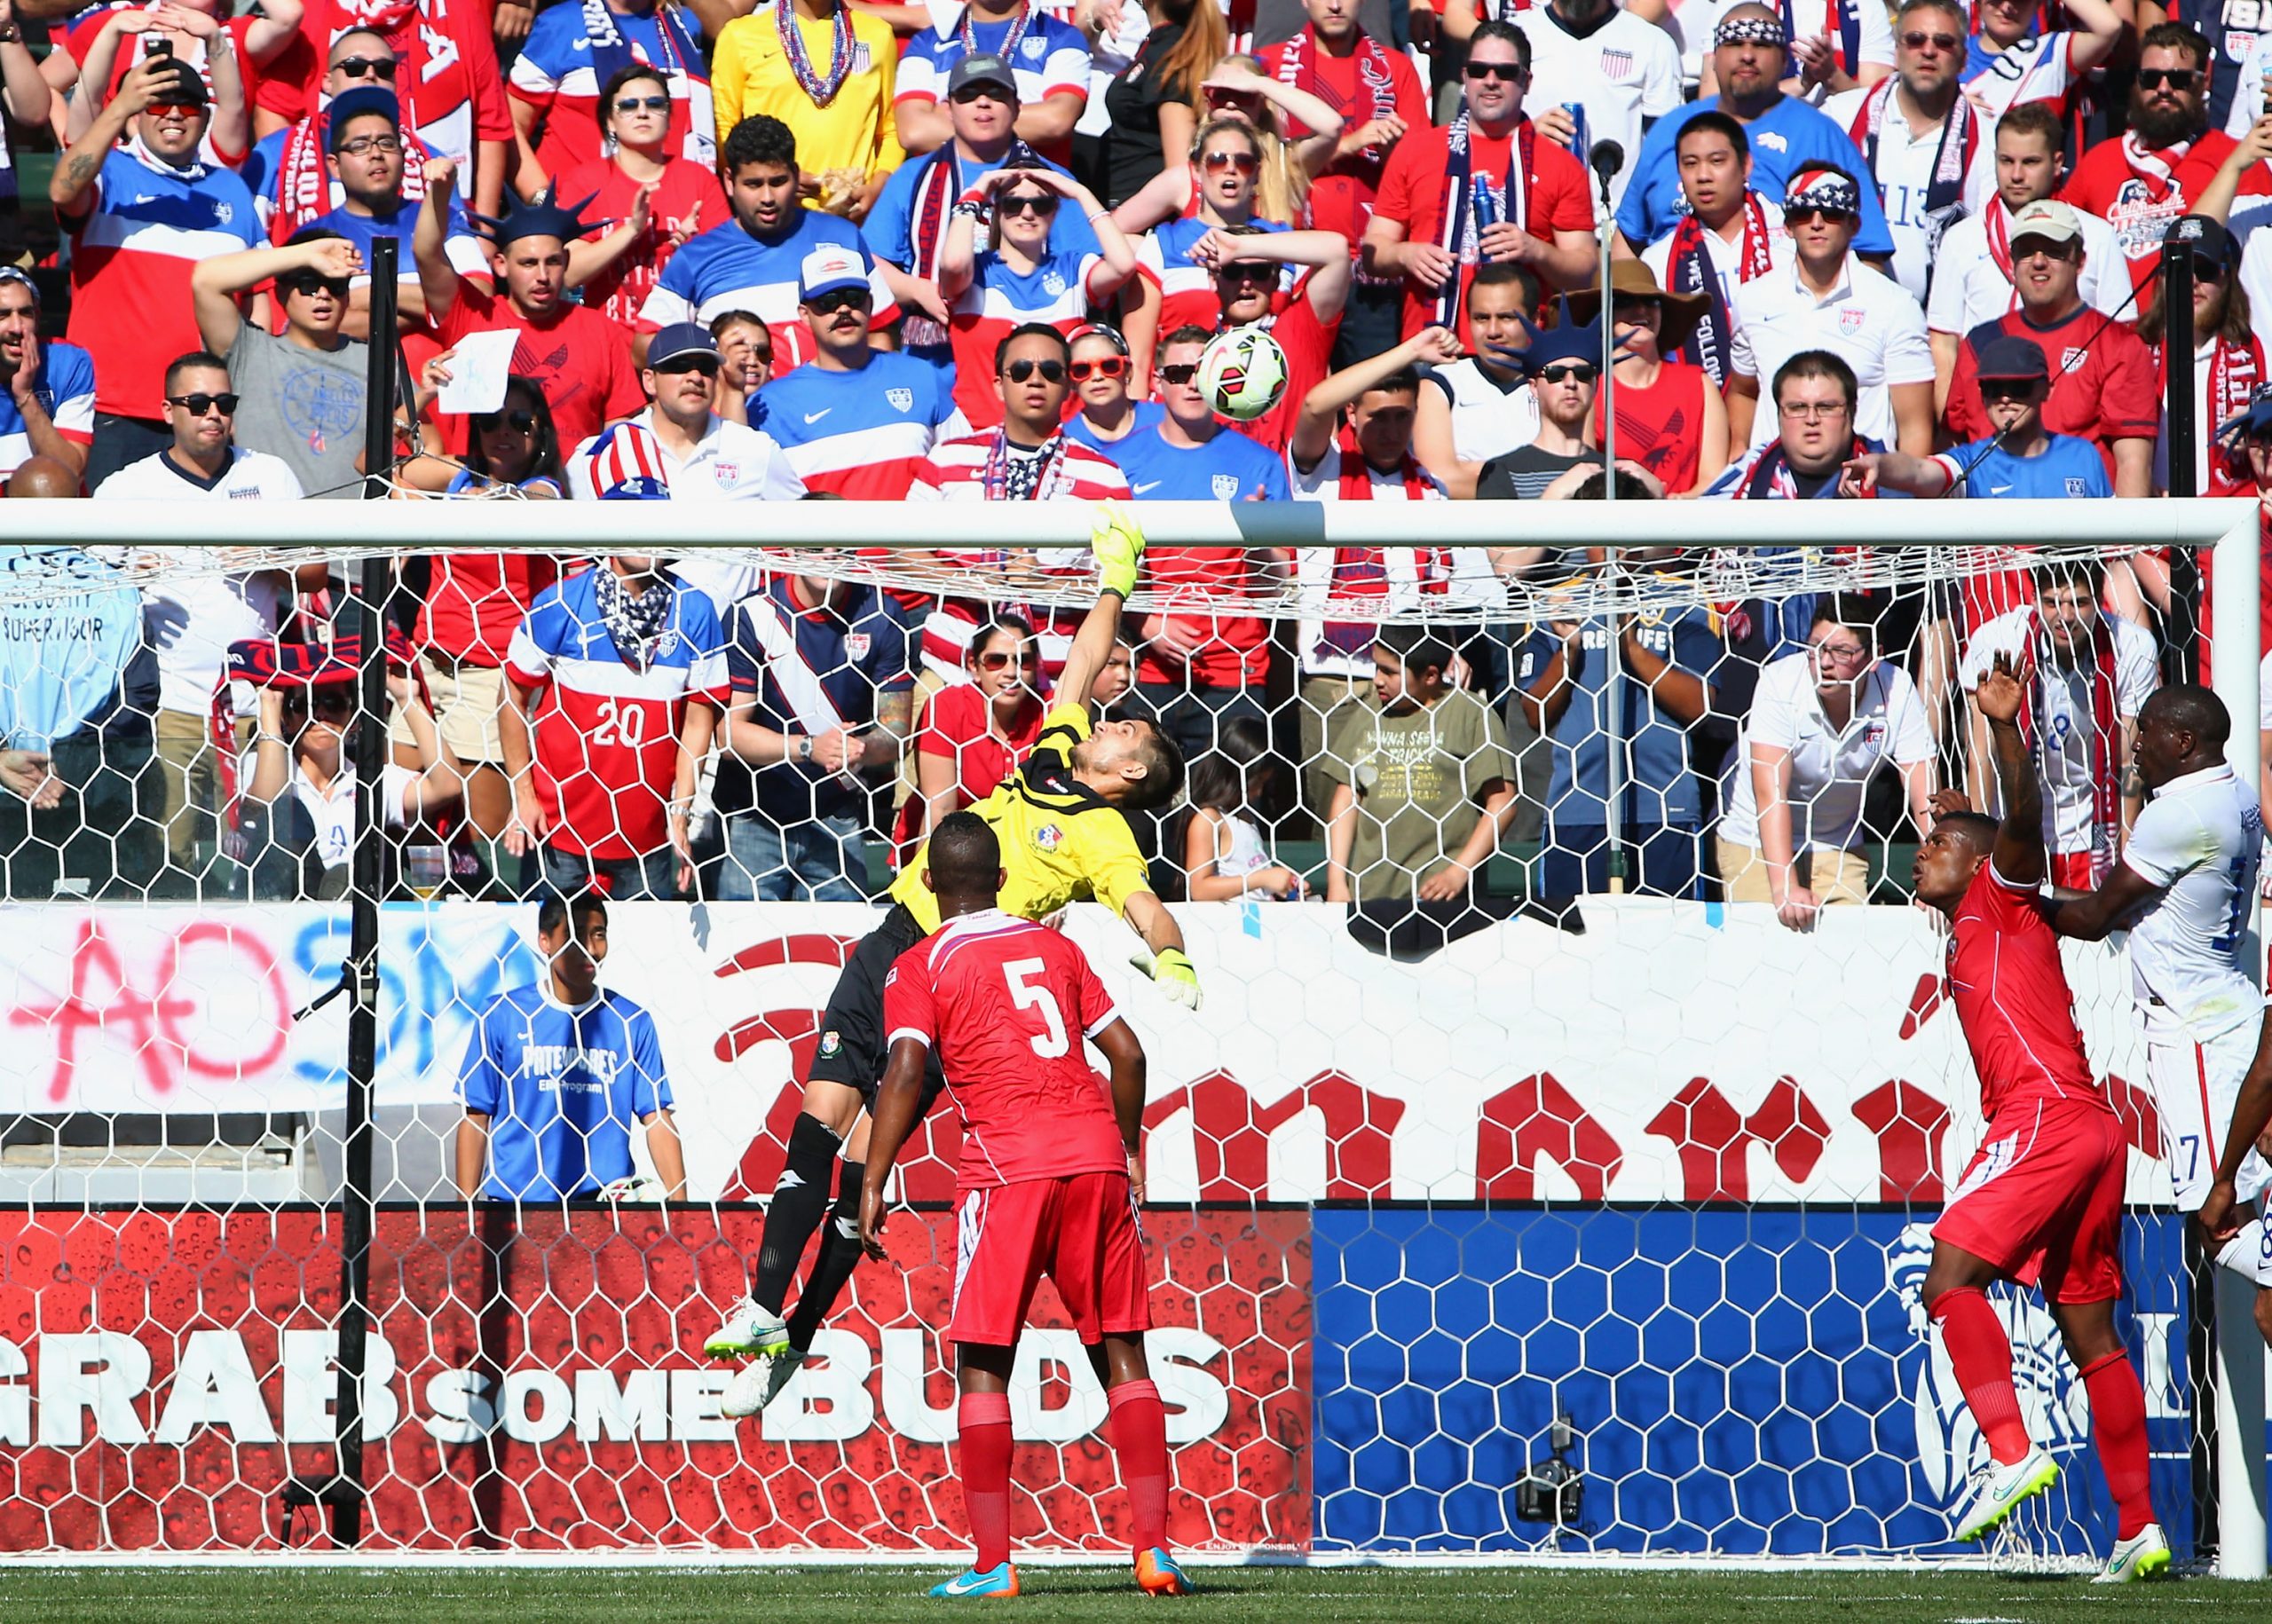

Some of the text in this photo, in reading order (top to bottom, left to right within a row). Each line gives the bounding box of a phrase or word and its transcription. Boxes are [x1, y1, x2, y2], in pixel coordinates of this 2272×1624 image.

[3, 616, 104, 643] SUPERVISOR
[593, 702, 645, 748] 20
[1002, 956, 1071, 1060] 5
[0, 1327, 1229, 1447] RAB SOME BUDS
